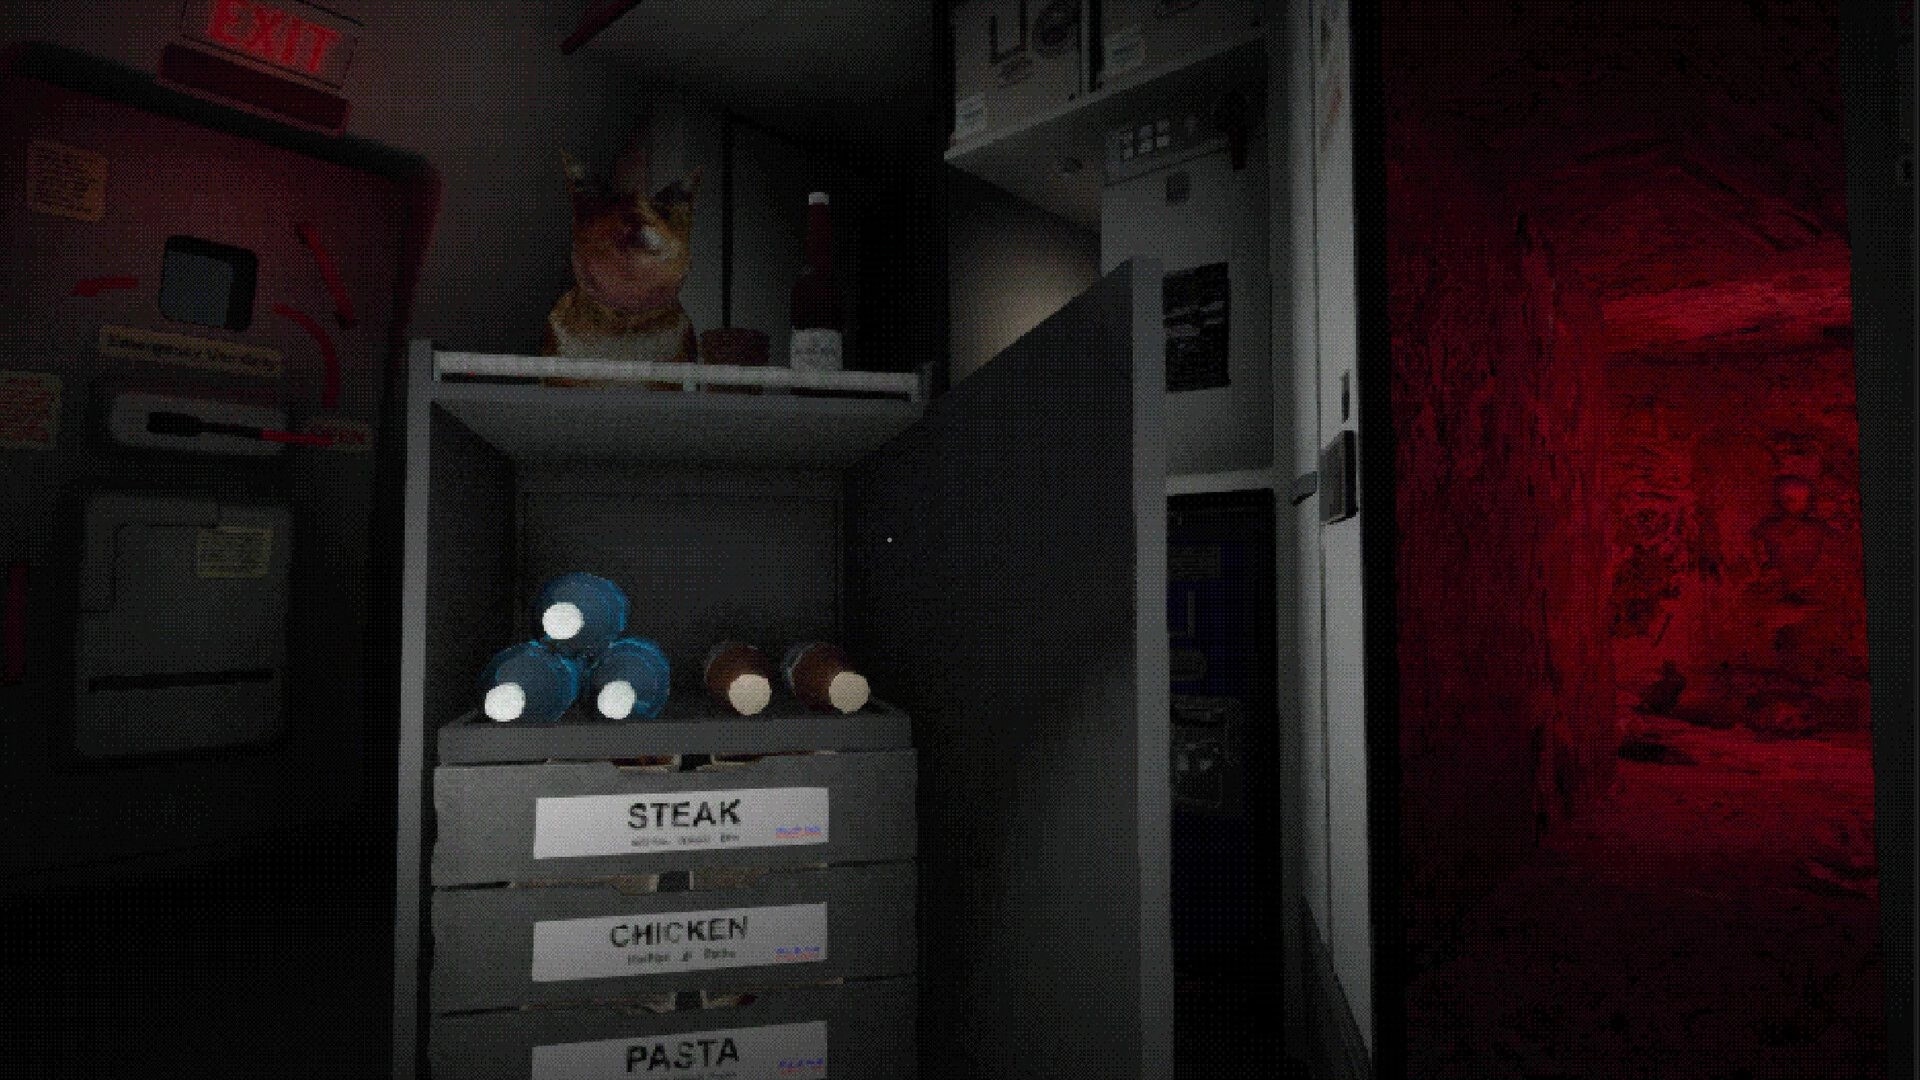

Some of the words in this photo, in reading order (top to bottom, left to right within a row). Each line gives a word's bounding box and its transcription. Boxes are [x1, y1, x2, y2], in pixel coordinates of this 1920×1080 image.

[211, 0, 340, 73] EXIT
[628, 798, 742, 829] STEAK
[610, 915, 748, 948] CHICKEN
[626, 1038, 740, 1072] PASTA
